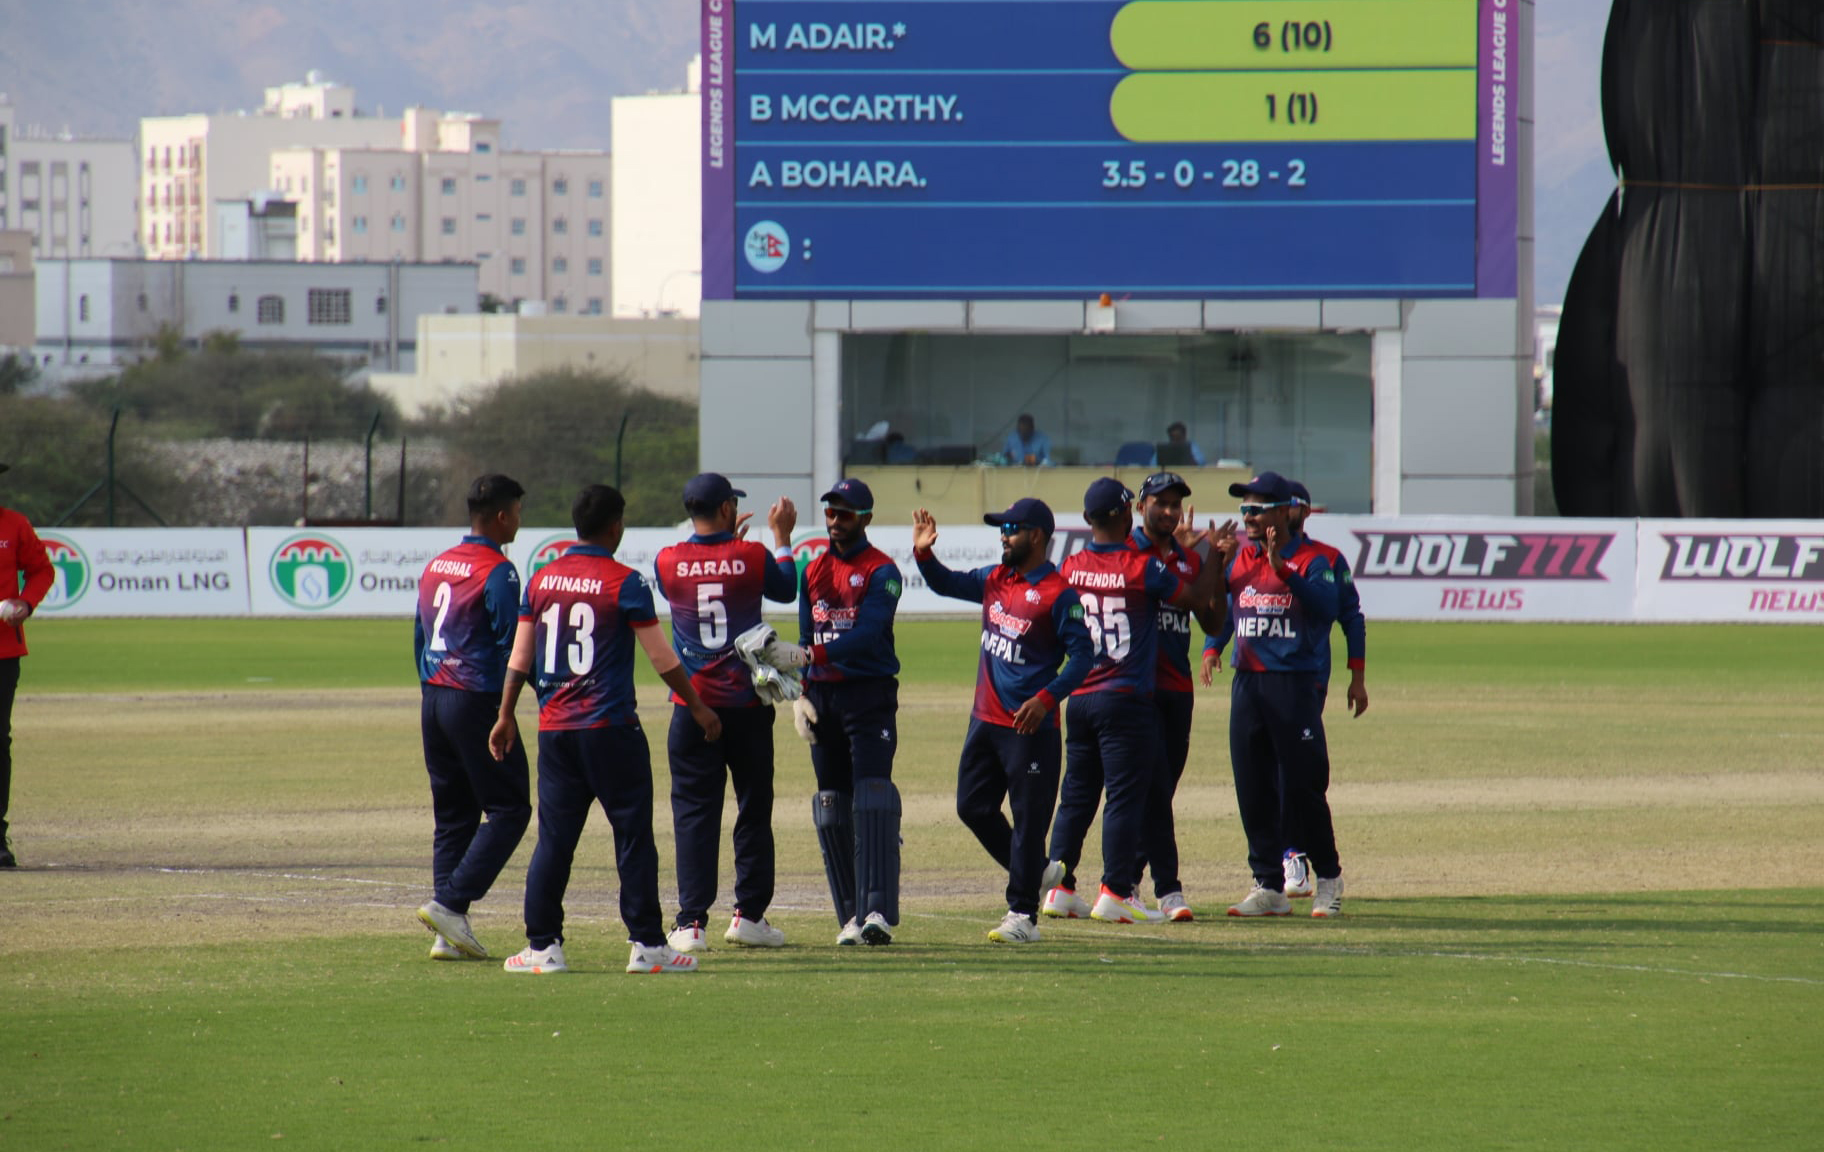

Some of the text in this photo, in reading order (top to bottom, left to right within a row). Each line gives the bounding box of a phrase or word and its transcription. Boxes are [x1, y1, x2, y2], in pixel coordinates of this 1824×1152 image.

[709, 15, 723, 85] LEAGUE
[749, 23, 777, 50] M
[1252, 20, 1332, 53] 6 (10)
[1492, 11, 1507, 82] LEAGUE
[750, 94, 964, 121] B MCCARTHY.
[1265, 92, 1318, 125] 1 (1)
[709, 87, 724, 168] LEGENDS
[1491, 84, 1506, 166] LEGENDS
[748, 160, 928, 188] A BOHARA.
[1102, 160, 1147, 188] 3.5
[1173, 160, 1194, 188] 0
[1222, 159, 1260, 187] 28
[1287, 158, 1307, 187] 2
[98, 571, 230, 592] Oman LNG
[360, 573, 420, 592] Oma
[429, 559, 473, 578] KUSHAL
[676, 560, 746, 578] SARAD
[1068, 570, 1126, 589] JITENDRA
[539, 575, 602, 595] AVINASH
[430, 581, 452, 651] 2
[697, 582, 728, 650] 5
[1080, 593, 1131, 661] 65
[1158, 612, 1190, 633] PAL
[1237, 617, 1297, 638] NEPAL
[541, 602, 595, 676] 13
[981, 629, 1026, 665] NEPAL
